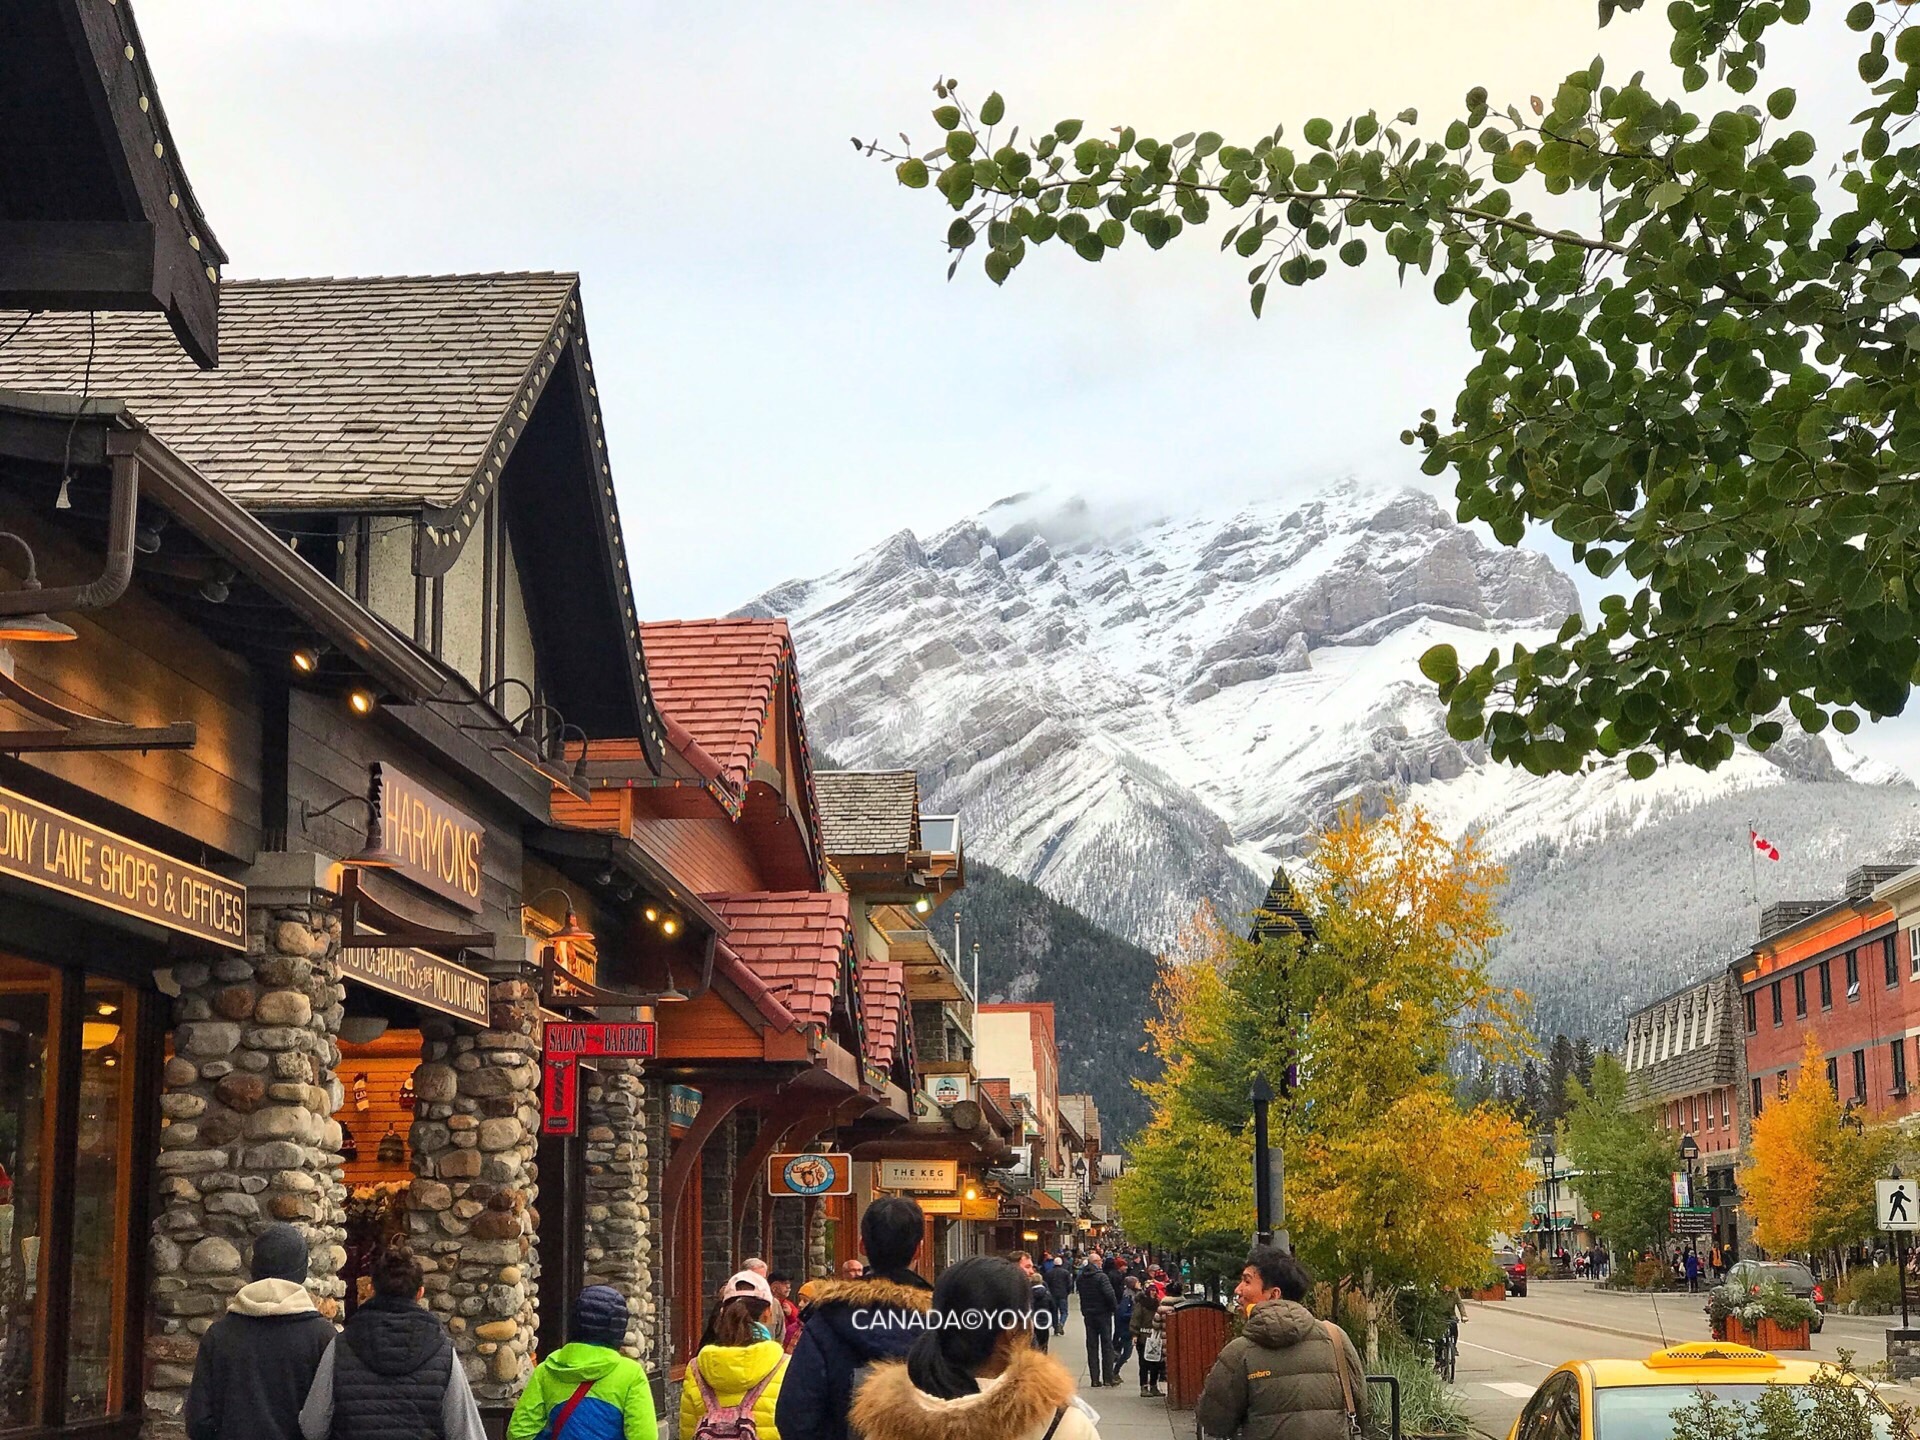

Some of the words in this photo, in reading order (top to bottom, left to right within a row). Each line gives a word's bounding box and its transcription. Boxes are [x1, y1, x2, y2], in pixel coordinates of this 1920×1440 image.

[385, 781, 479, 898] HARMONS
[44, 822, 94, 886] LANE
[99, 844, 158, 908] SHOPS
[163, 871, 176, 914] &
[180, 876, 242, 937] OFFICES
[433, 966, 485, 1016] MOUNTAINS
[549, 1027, 587, 1052] SALON
[604, 1027, 648, 1053] BARBER
[893, 1168, 915, 1177] THE
[920, 1169, 944, 1177] KEG
